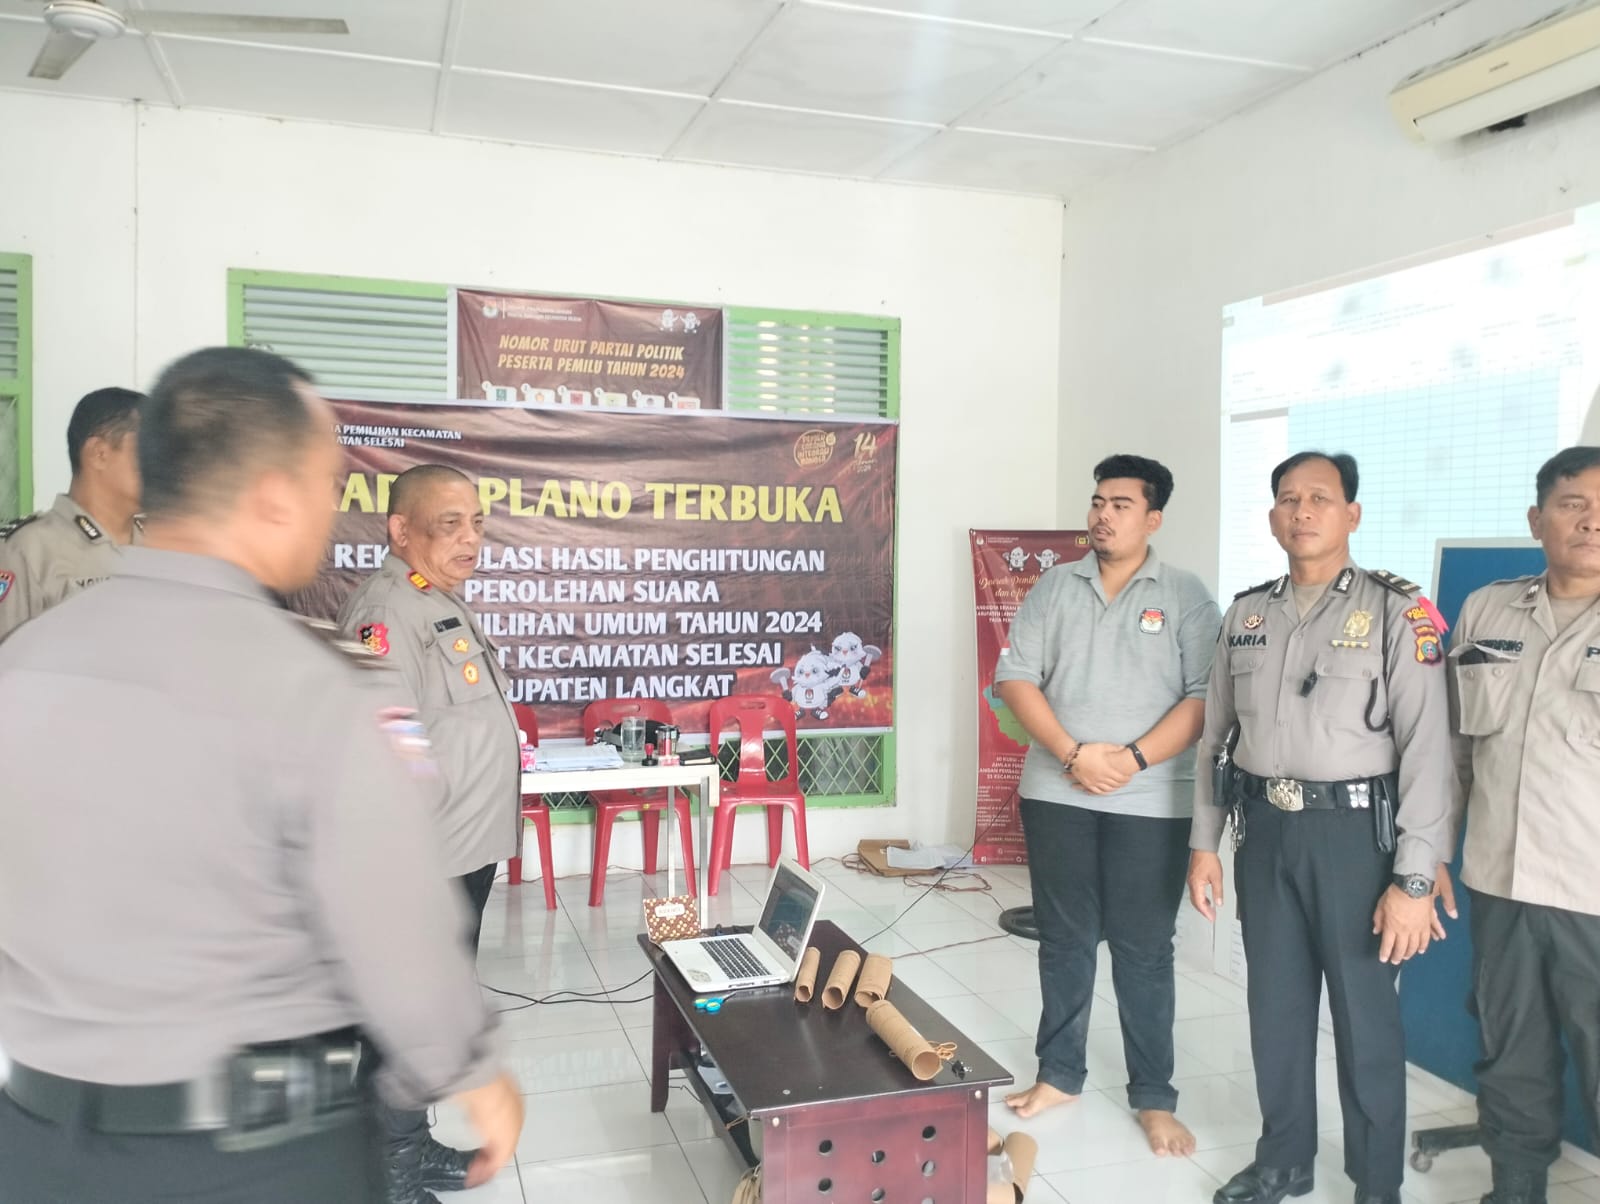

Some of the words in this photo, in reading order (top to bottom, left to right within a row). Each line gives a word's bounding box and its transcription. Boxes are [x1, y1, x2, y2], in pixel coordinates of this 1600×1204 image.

[499, 335, 549, 351] NOMOR
[553, 338, 586, 354] URUT
[590, 341, 634, 358] PARTAI
[636, 344, 685, 361] POLITIK
[497, 354, 553, 371] PESERTA
[557, 357, 601, 374] PEMILU
[607, 360, 646, 377] TAHUN
[650, 363, 685, 379] 2024
[343, 424, 400, 437] PEMILIHAN
[401, 428, 462, 440] KECAMATAN
[363, 436, 405, 448] SELESAI
[853, 432, 877, 459] 14
[478, 477, 632, 520] PLANO
[645, 482, 843, 523] TERBUKA
[552, 547, 628, 571] HASIL
[634, 548, 825, 572] PENGHITUNGAN
[465, 579, 625, 603] PEROLEHAN
[633, 580, 720, 603] SUARA
[584, 611, 667, 635] UMUM
[676, 611, 758, 635] TAHUN
[765, 610, 822, 633] 2024
[518, 644, 678, 669] KECAMATAN
[685, 642, 782, 667] SELESAI
[507, 676, 607, 703] UPATEN
[616, 674, 734, 699] LANGKAT
